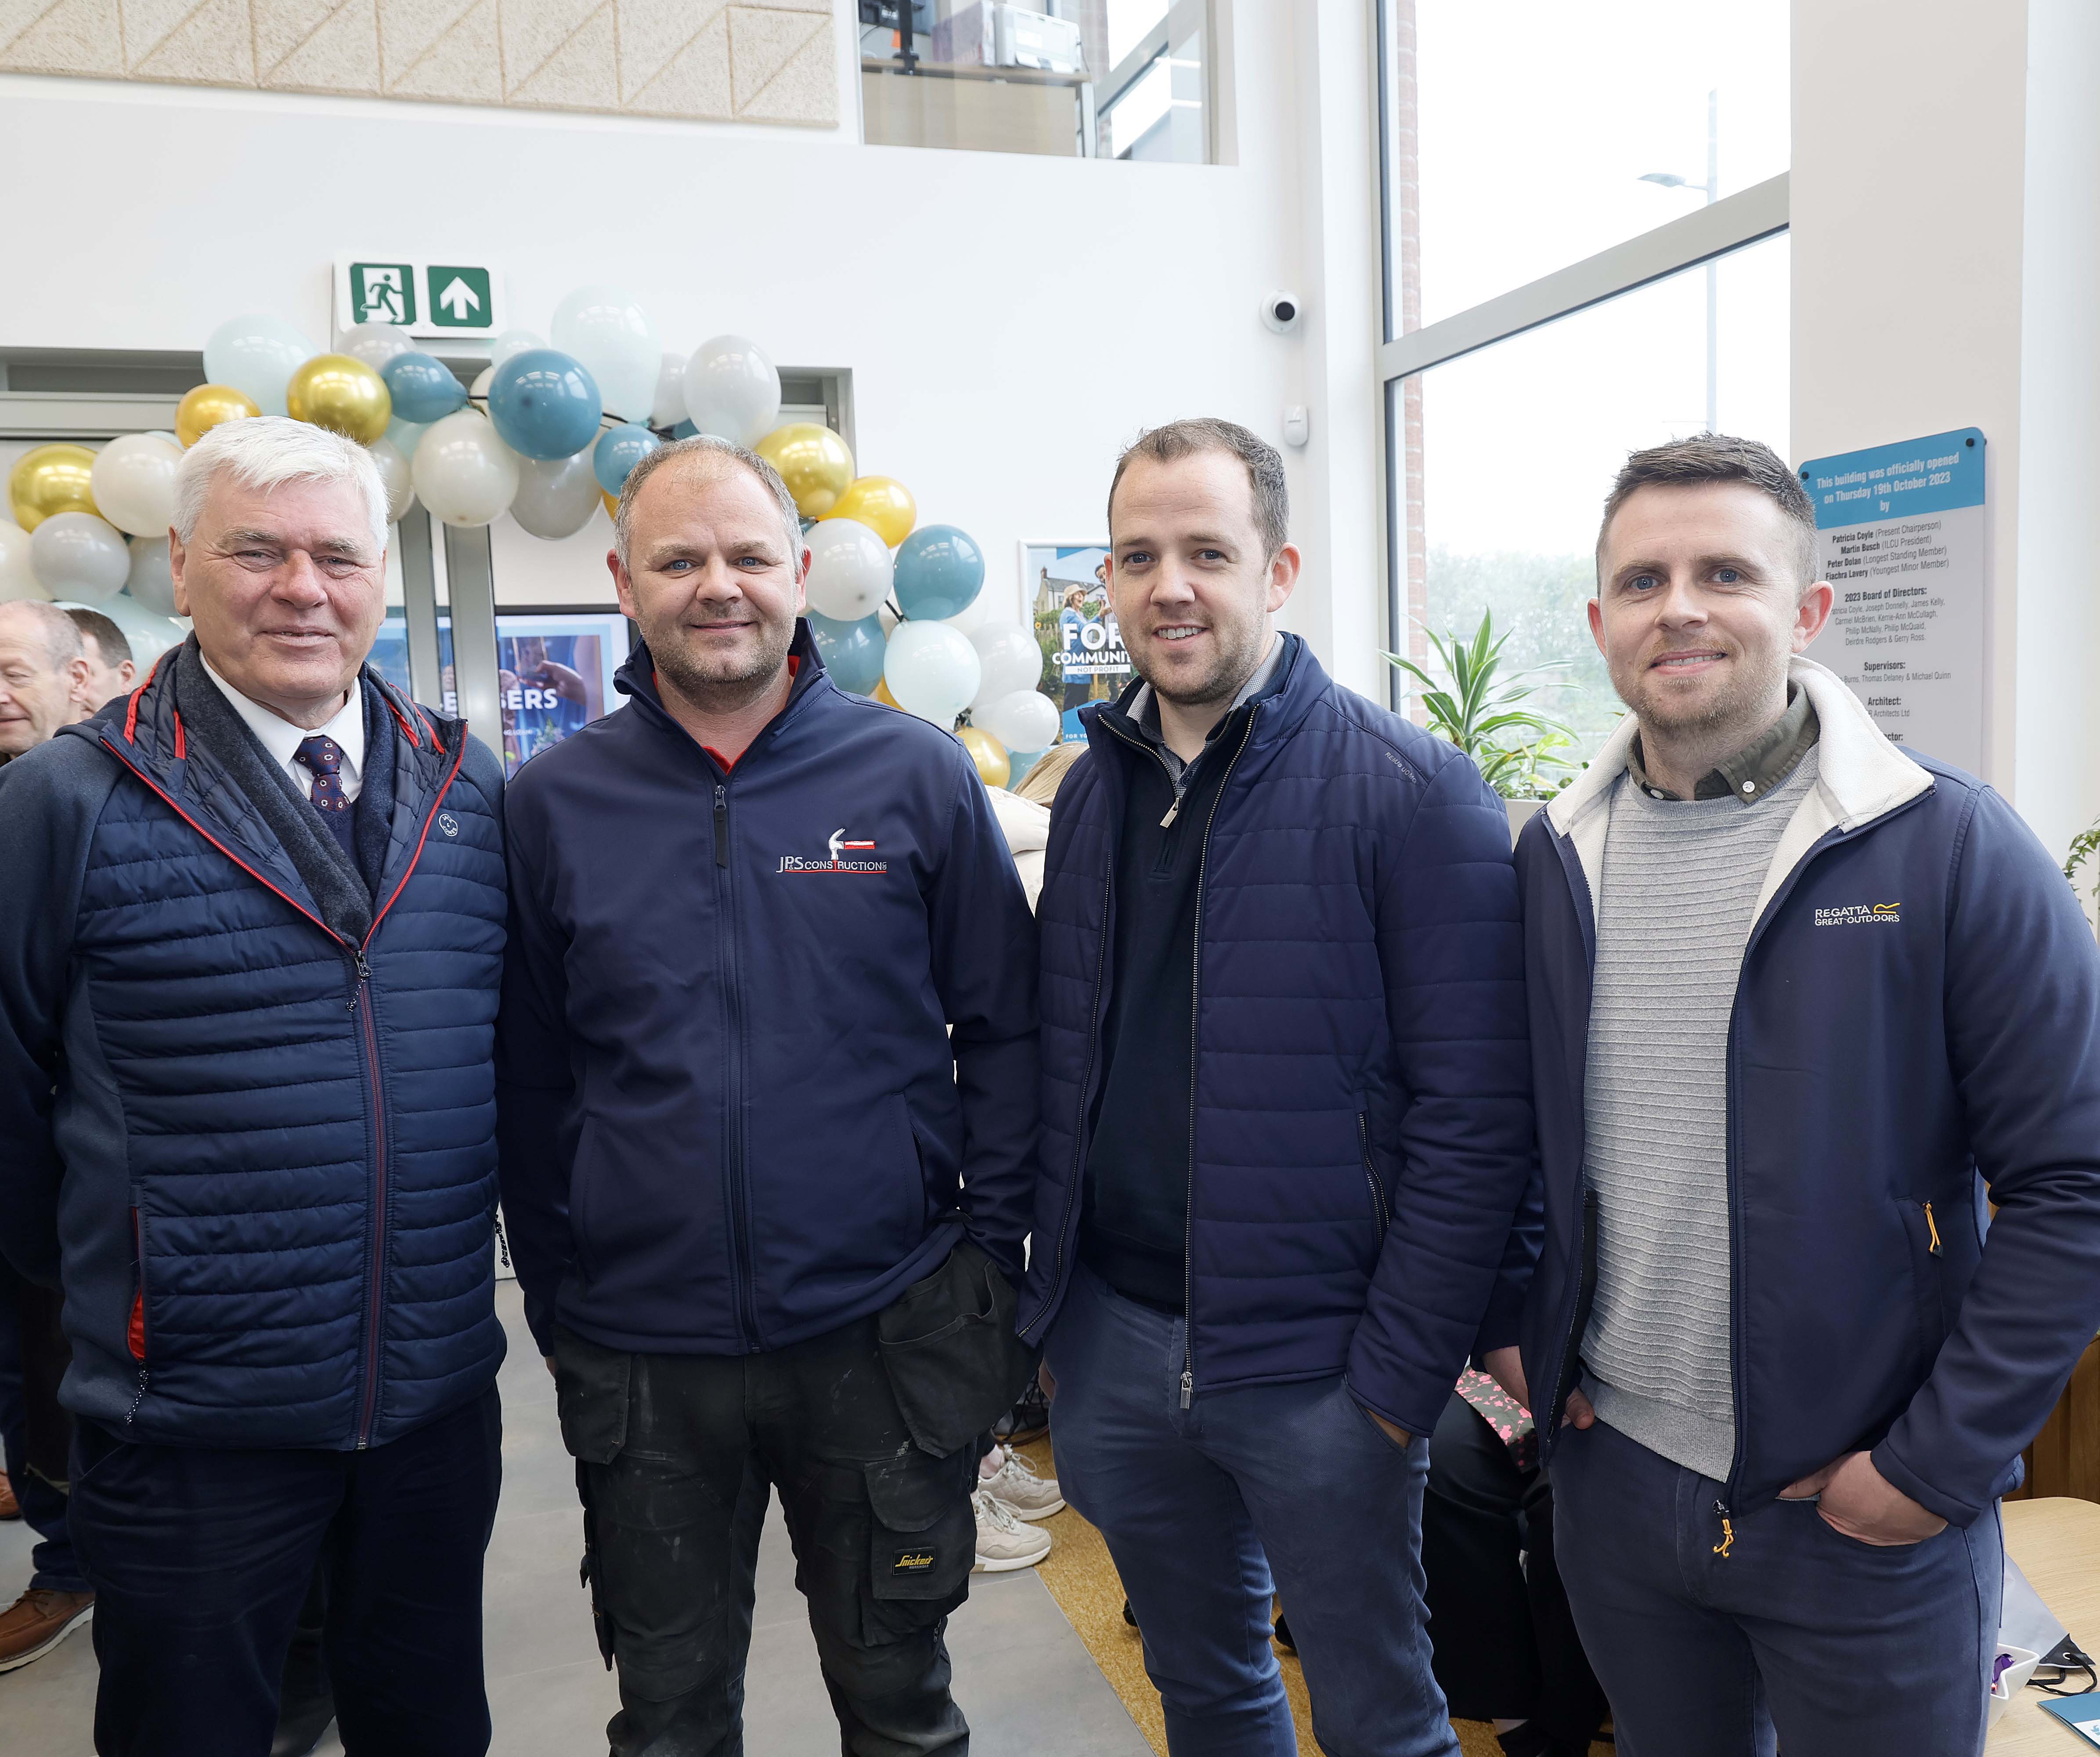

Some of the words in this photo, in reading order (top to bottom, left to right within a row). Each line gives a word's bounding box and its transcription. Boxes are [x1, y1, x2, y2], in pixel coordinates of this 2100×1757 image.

[1817, 477, 1833, 489] This
[1835, 471, 1867, 484] building
[1869, 467, 1885, 479] was
[1887, 459, 1925, 476] officially
[1927, 452, 1959, 470] opened
[1824, 494, 1833, 504] on
[1836, 485, 1871, 502] Thursday
[1873, 483, 1891, 496] 19th
[1894, 478, 1926, 492] October
[1929, 471, 1951, 485] 2023
[1880, 500, 1890, 513] by
[1833, 532, 1856, 543] Patricia
[1857, 530, 1873, 541] Coyle
[1876, 527, 1900, 539] (Present
[1902, 521, 1941, 534] Chairperson)
[1841, 545, 1861, 555] Martin
[1862, 542, 1880, 553] Busch
[1882, 539, 1898, 551] (ILCU
[1901, 535, 1932, 545] President)
[1828, 559, 1844, 569] Peter
[1844, 557, 1862, 566] Dolan
[1863, 553, 1889, 564] (Longest
[1891, 550, 1917, 561] Standing
[1919, 546, 1947, 557] Member)
[1849, 569, 1868, 578] Lavery
[1870, 565, 1900, 577] (Youngest
[1901, 561, 1919, 571] Minor
[1920, 559, 1949, 569] Member)
[1845, 592, 1861, 602] 2023
[1863, 590, 1883, 600] Board
[1884, 589, 1891, 598] of
[1893, 587, 1927, 597] Directors:
[1831, 605, 1848, 615] atricia
[1865, 602, 1884, 612] Joseph
[1886, 600, 1910, 610] Donnelly,
[1911, 599, 1929, 607] James
[1835, 615, 1853, 625] Carmel
[1063, 622, 1125, 650] FOR
[1846, 626, 1860, 636] Philip
[1885, 623, 1899, 633] Philip
[1865, 635, 1887, 645] Rodgers
[1894, 634, 1909, 644] Gerry
[1865, 661, 1905, 672] Supervisors:
[1862, 674, 1882, 683] Thomas
[1884, 673, 1904, 682] Delaney
[1868, 697, 1901, 705] Architect:
[1385, 752, 1402, 767] REMUS
[1401, 766, 1417, 784] UOMO
[1815, 905, 1871, 918] REGATTA
[1815, 918, 1844, 926] GREAT
[1847, 914, 1900, 923] OUTDOORS
